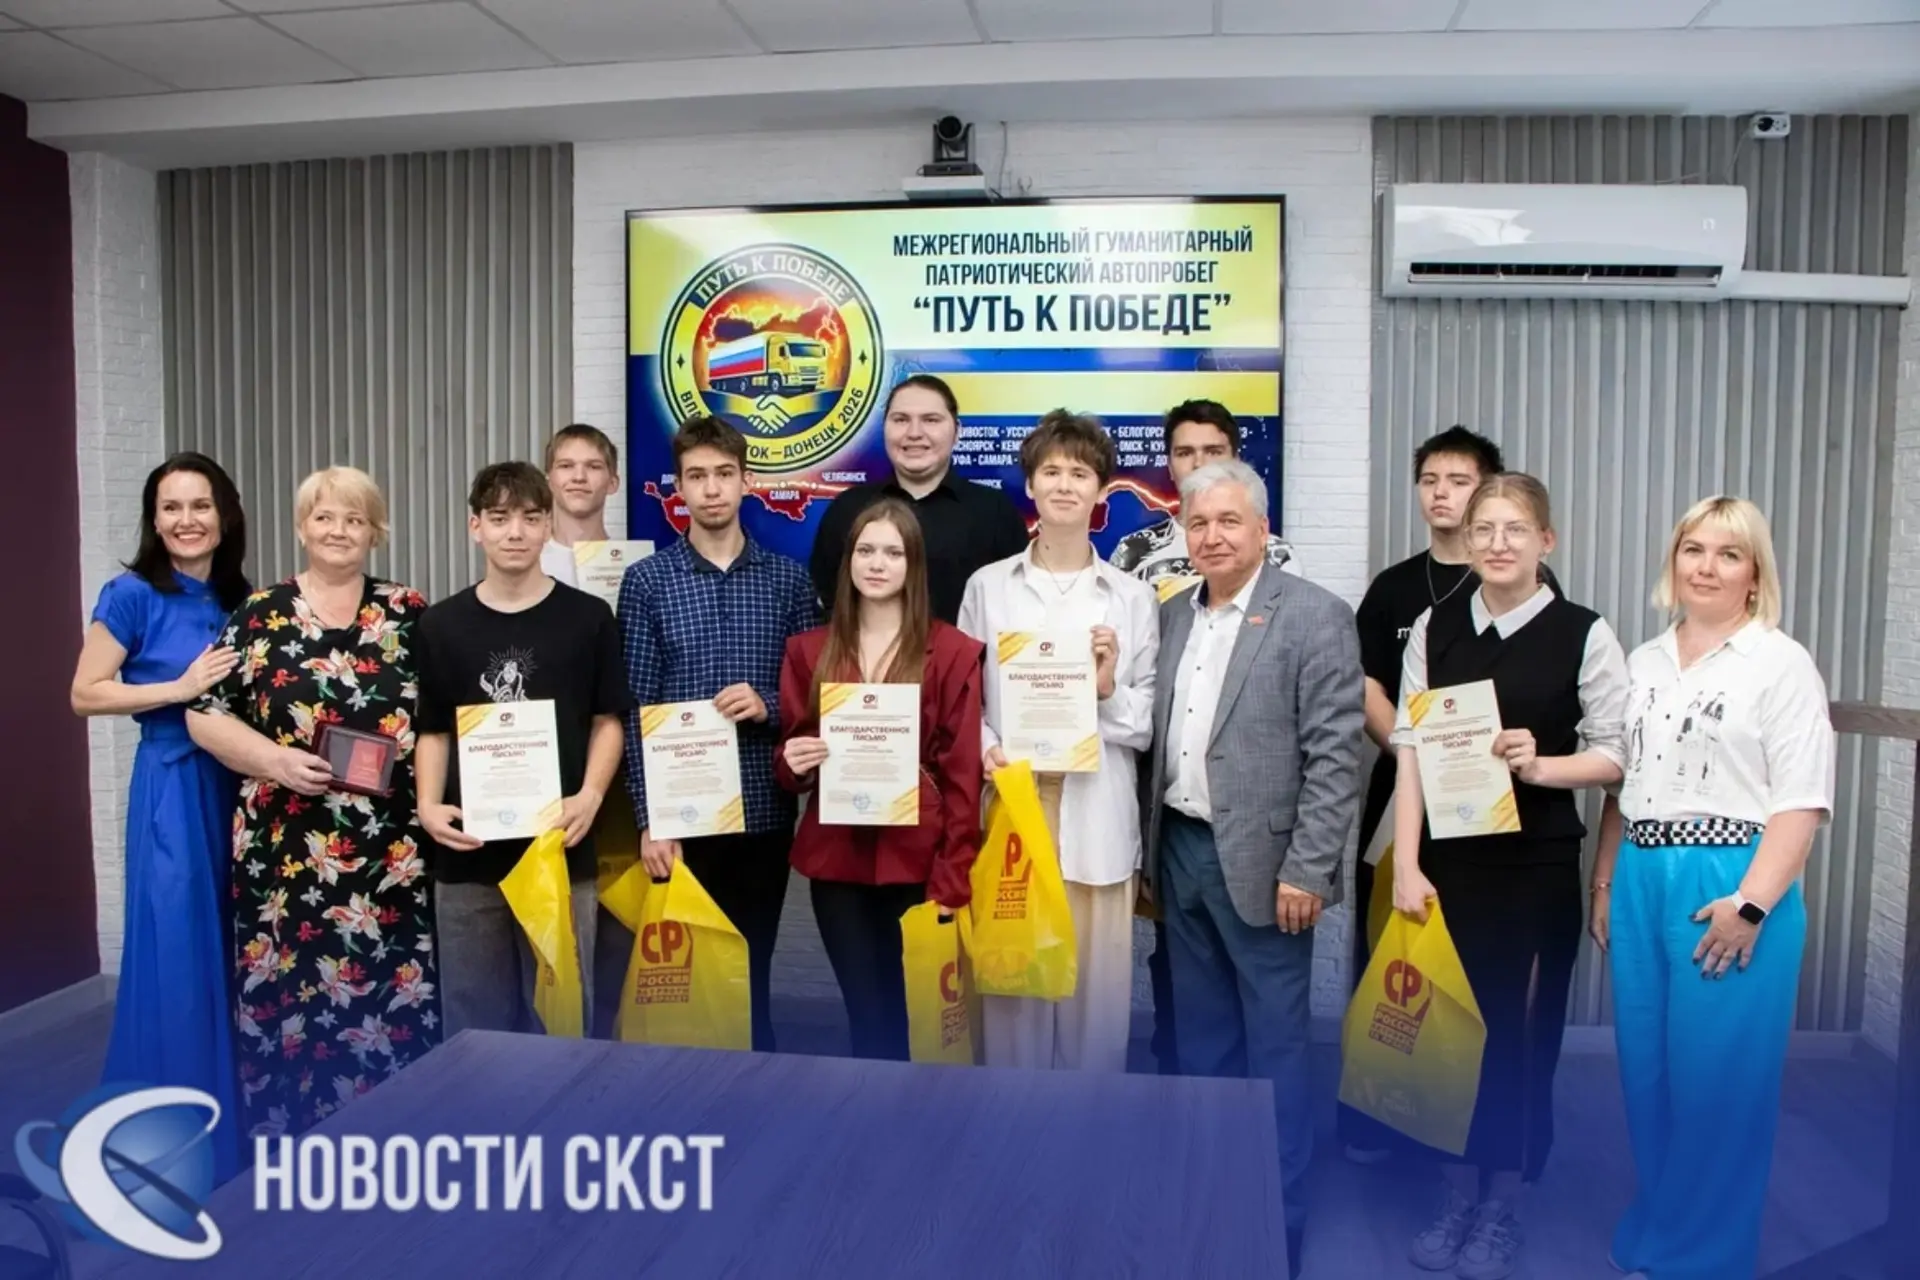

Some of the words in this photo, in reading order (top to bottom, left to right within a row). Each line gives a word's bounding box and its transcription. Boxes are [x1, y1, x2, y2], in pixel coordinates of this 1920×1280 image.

[893, 227, 1090, 256] МЕЖРЕГИОНАЛЬНЫЙ
[1095, 225, 1253, 253] ГУМАНИТАРНЫЙ
[696, 261, 748, 304] ПУТЬ
[751, 254, 768, 273] К
[773, 253, 851, 302] ПОБЕДЕ
[926, 257, 1095, 286] ПАТРИОТИЧЕСКИЙ
[1100, 260, 1219, 284] АВТОПРОБЕГ
[1036, 295, 1058, 332] К
[838, 387, 863, 424] 2026
[978, 454, 1013, 465] САМАРА
[769, 490, 800, 500] САМАРА
[829, 725, 910, 734] БЛАГОДАРСТВЕННОЕ
[852, 734, 887, 742] ПИСЬМО
[638, 975, 689, 987] РОССИЯ
